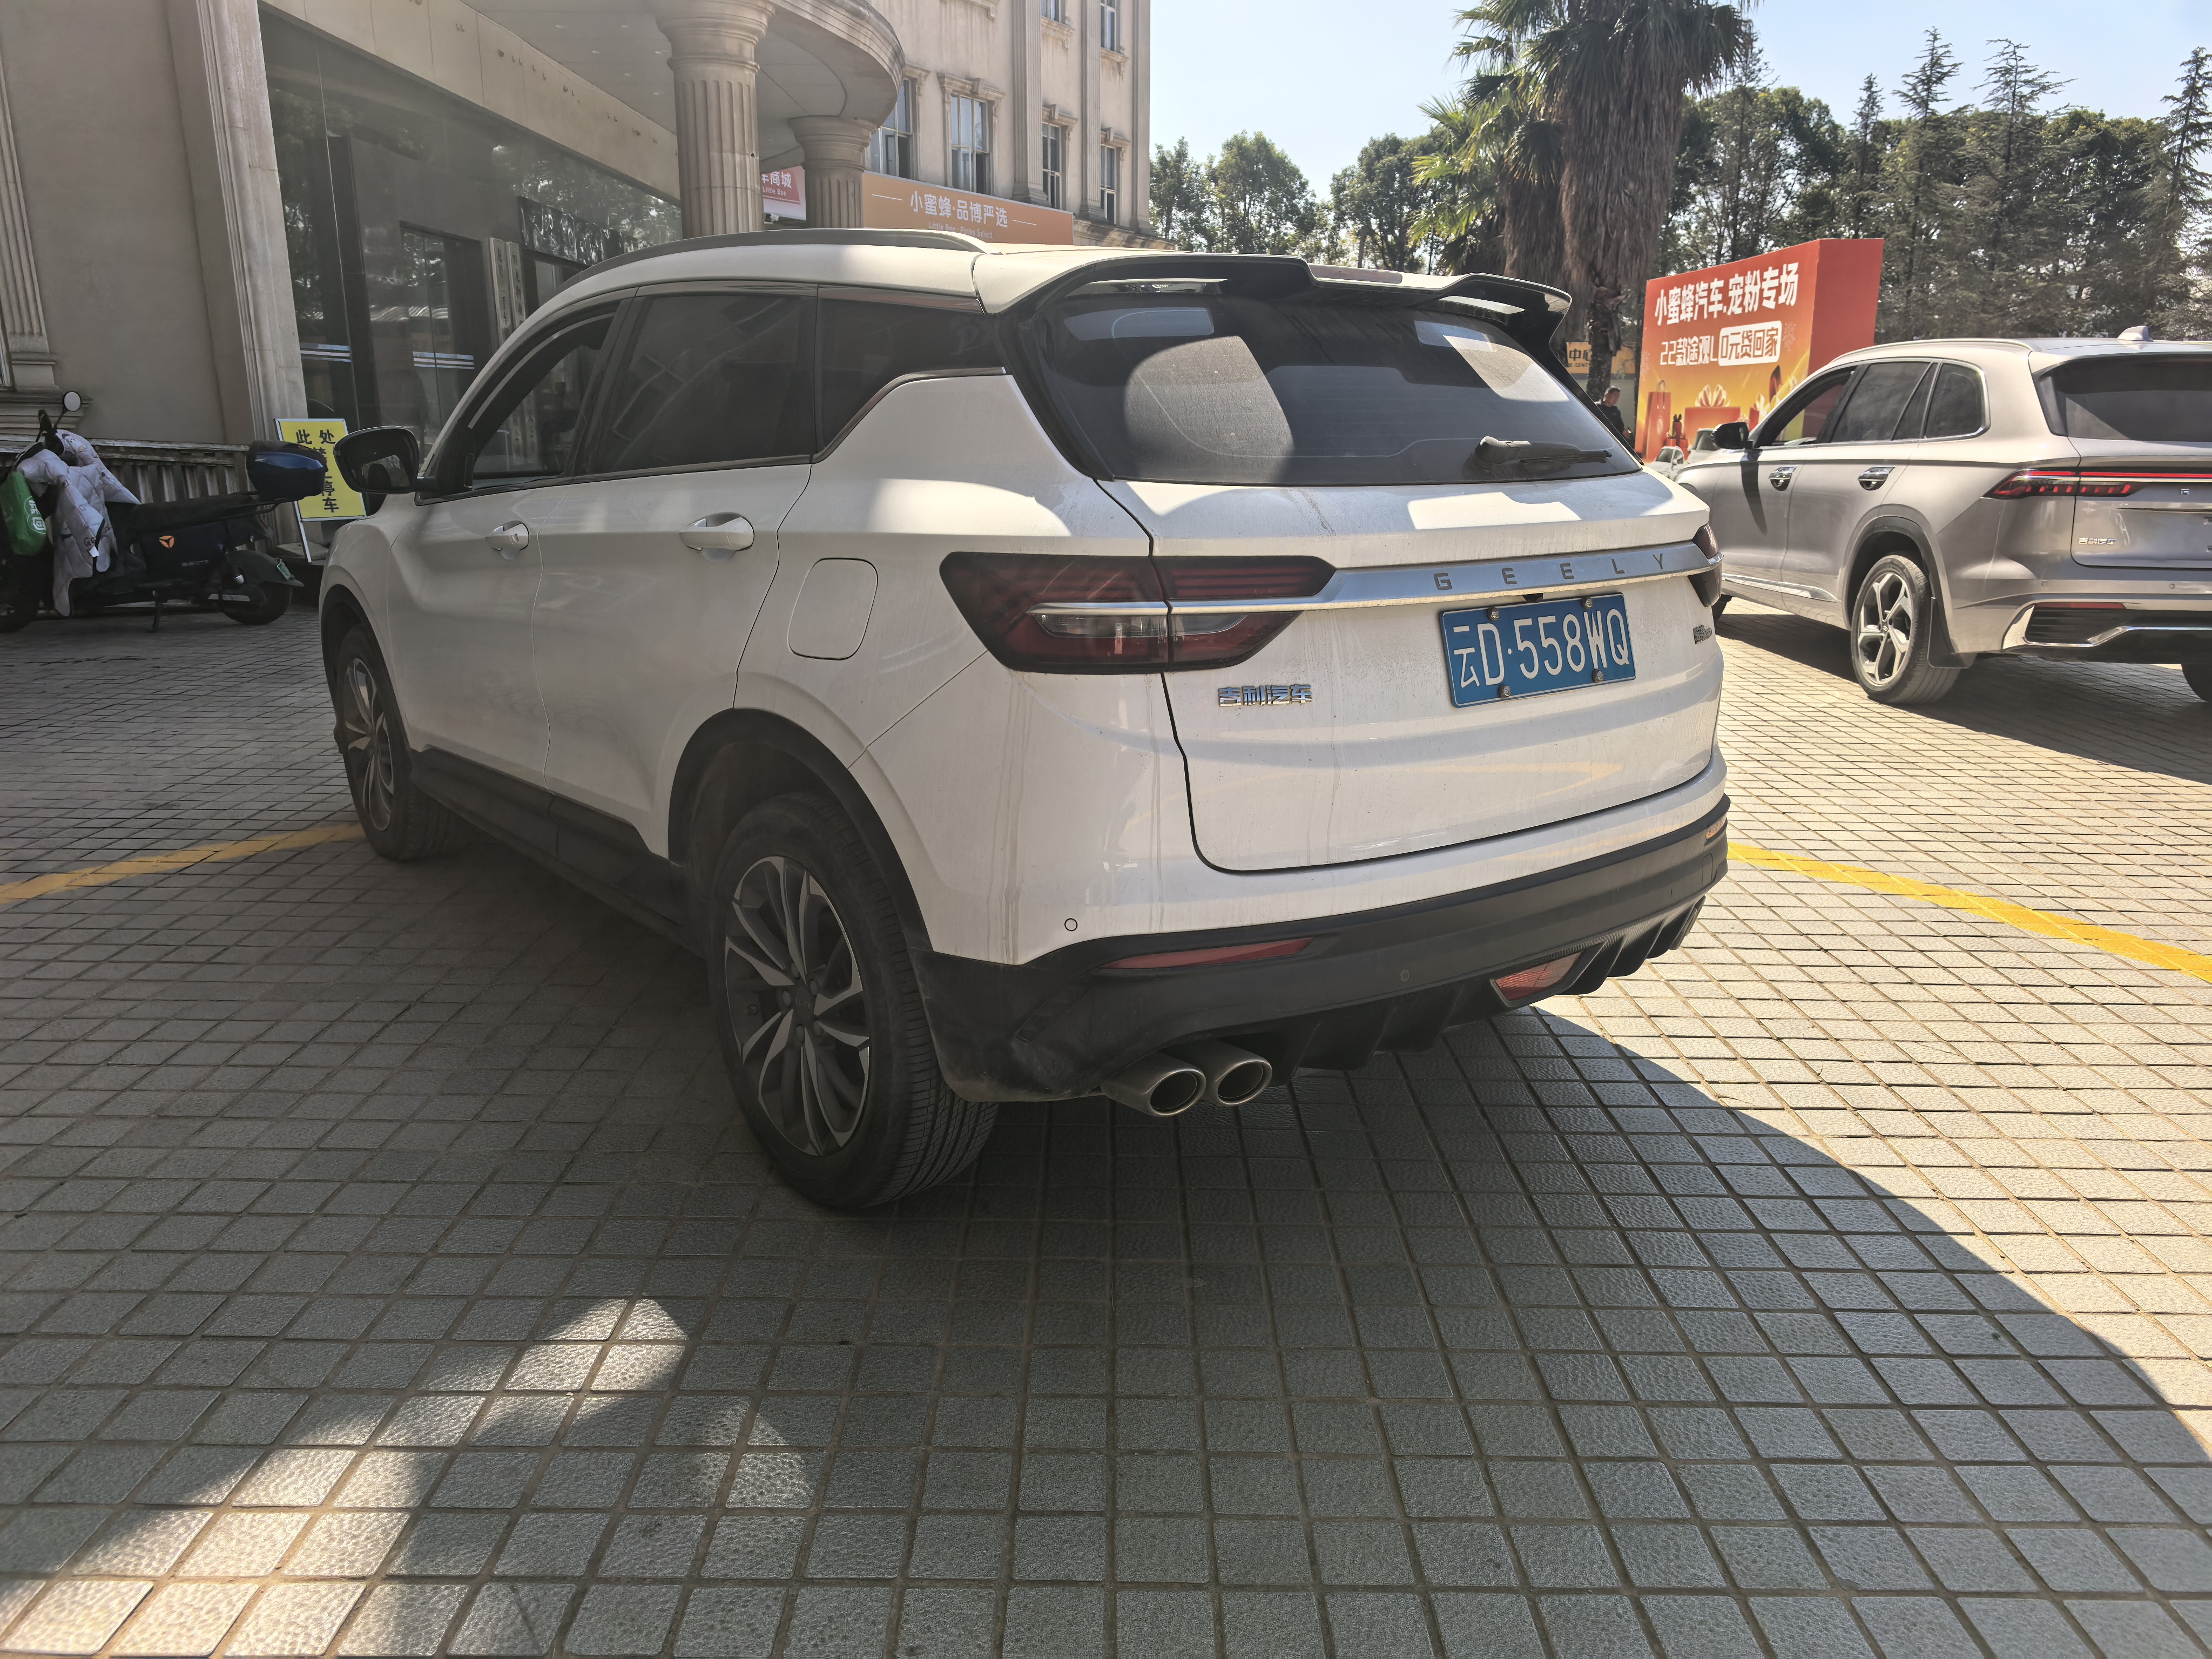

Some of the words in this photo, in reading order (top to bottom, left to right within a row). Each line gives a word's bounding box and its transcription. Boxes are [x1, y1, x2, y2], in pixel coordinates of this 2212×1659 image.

[911, 191, 1008, 228] 小蜜蜂·品博严选
[928, 221, 944, 231] Little
[976, 229, 993, 239] Select
[296, 429, 335, 444] 此处
[1433, 553, 1663, 590] GEELY
[1453, 608, 1630, 688] 云D·558WQ
[1218, 684, 1312, 707] 吉利汽车
